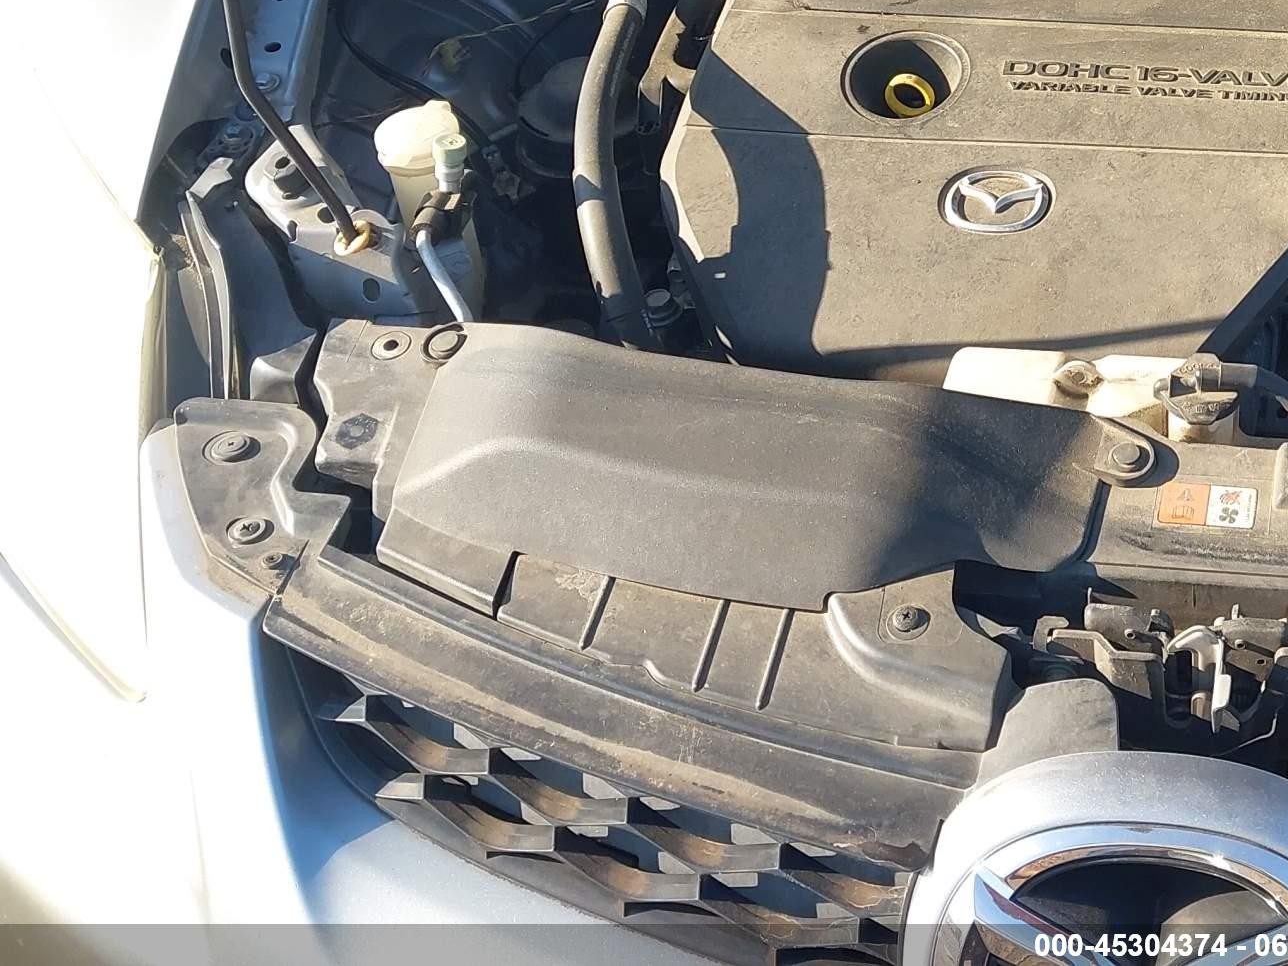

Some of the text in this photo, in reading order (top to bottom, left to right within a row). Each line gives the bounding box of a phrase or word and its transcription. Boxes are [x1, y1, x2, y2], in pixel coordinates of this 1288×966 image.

[1003, 60, 1132, 80] DOHC
[1009, 81, 1131, 95] VARIABLE
[1137, 86, 1214, 99] VALVE
